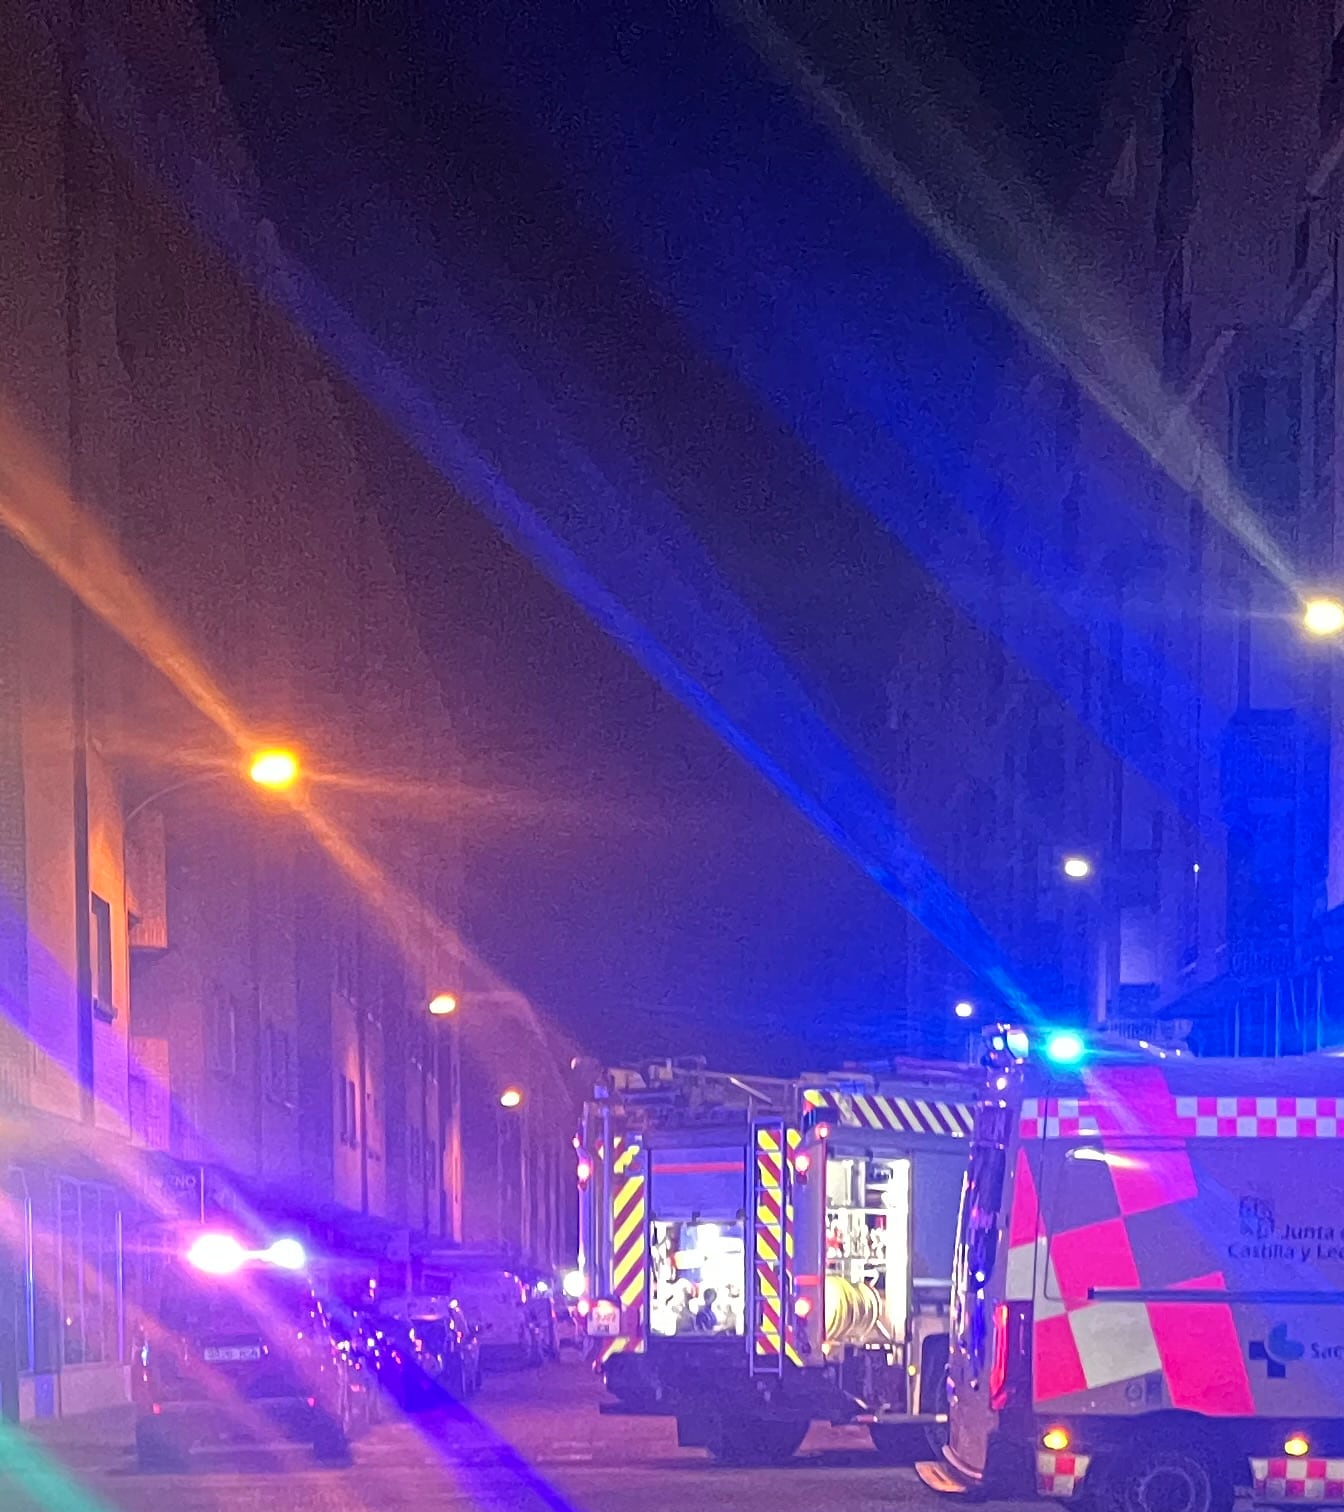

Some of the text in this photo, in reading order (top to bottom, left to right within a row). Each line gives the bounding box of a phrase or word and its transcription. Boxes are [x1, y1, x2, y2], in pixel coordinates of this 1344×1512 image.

[1280, 1223, 1334, 1241] Junta
[1227, 1243, 1295, 1260] Castilla
[1300, 1246, 1312, 1263] y
